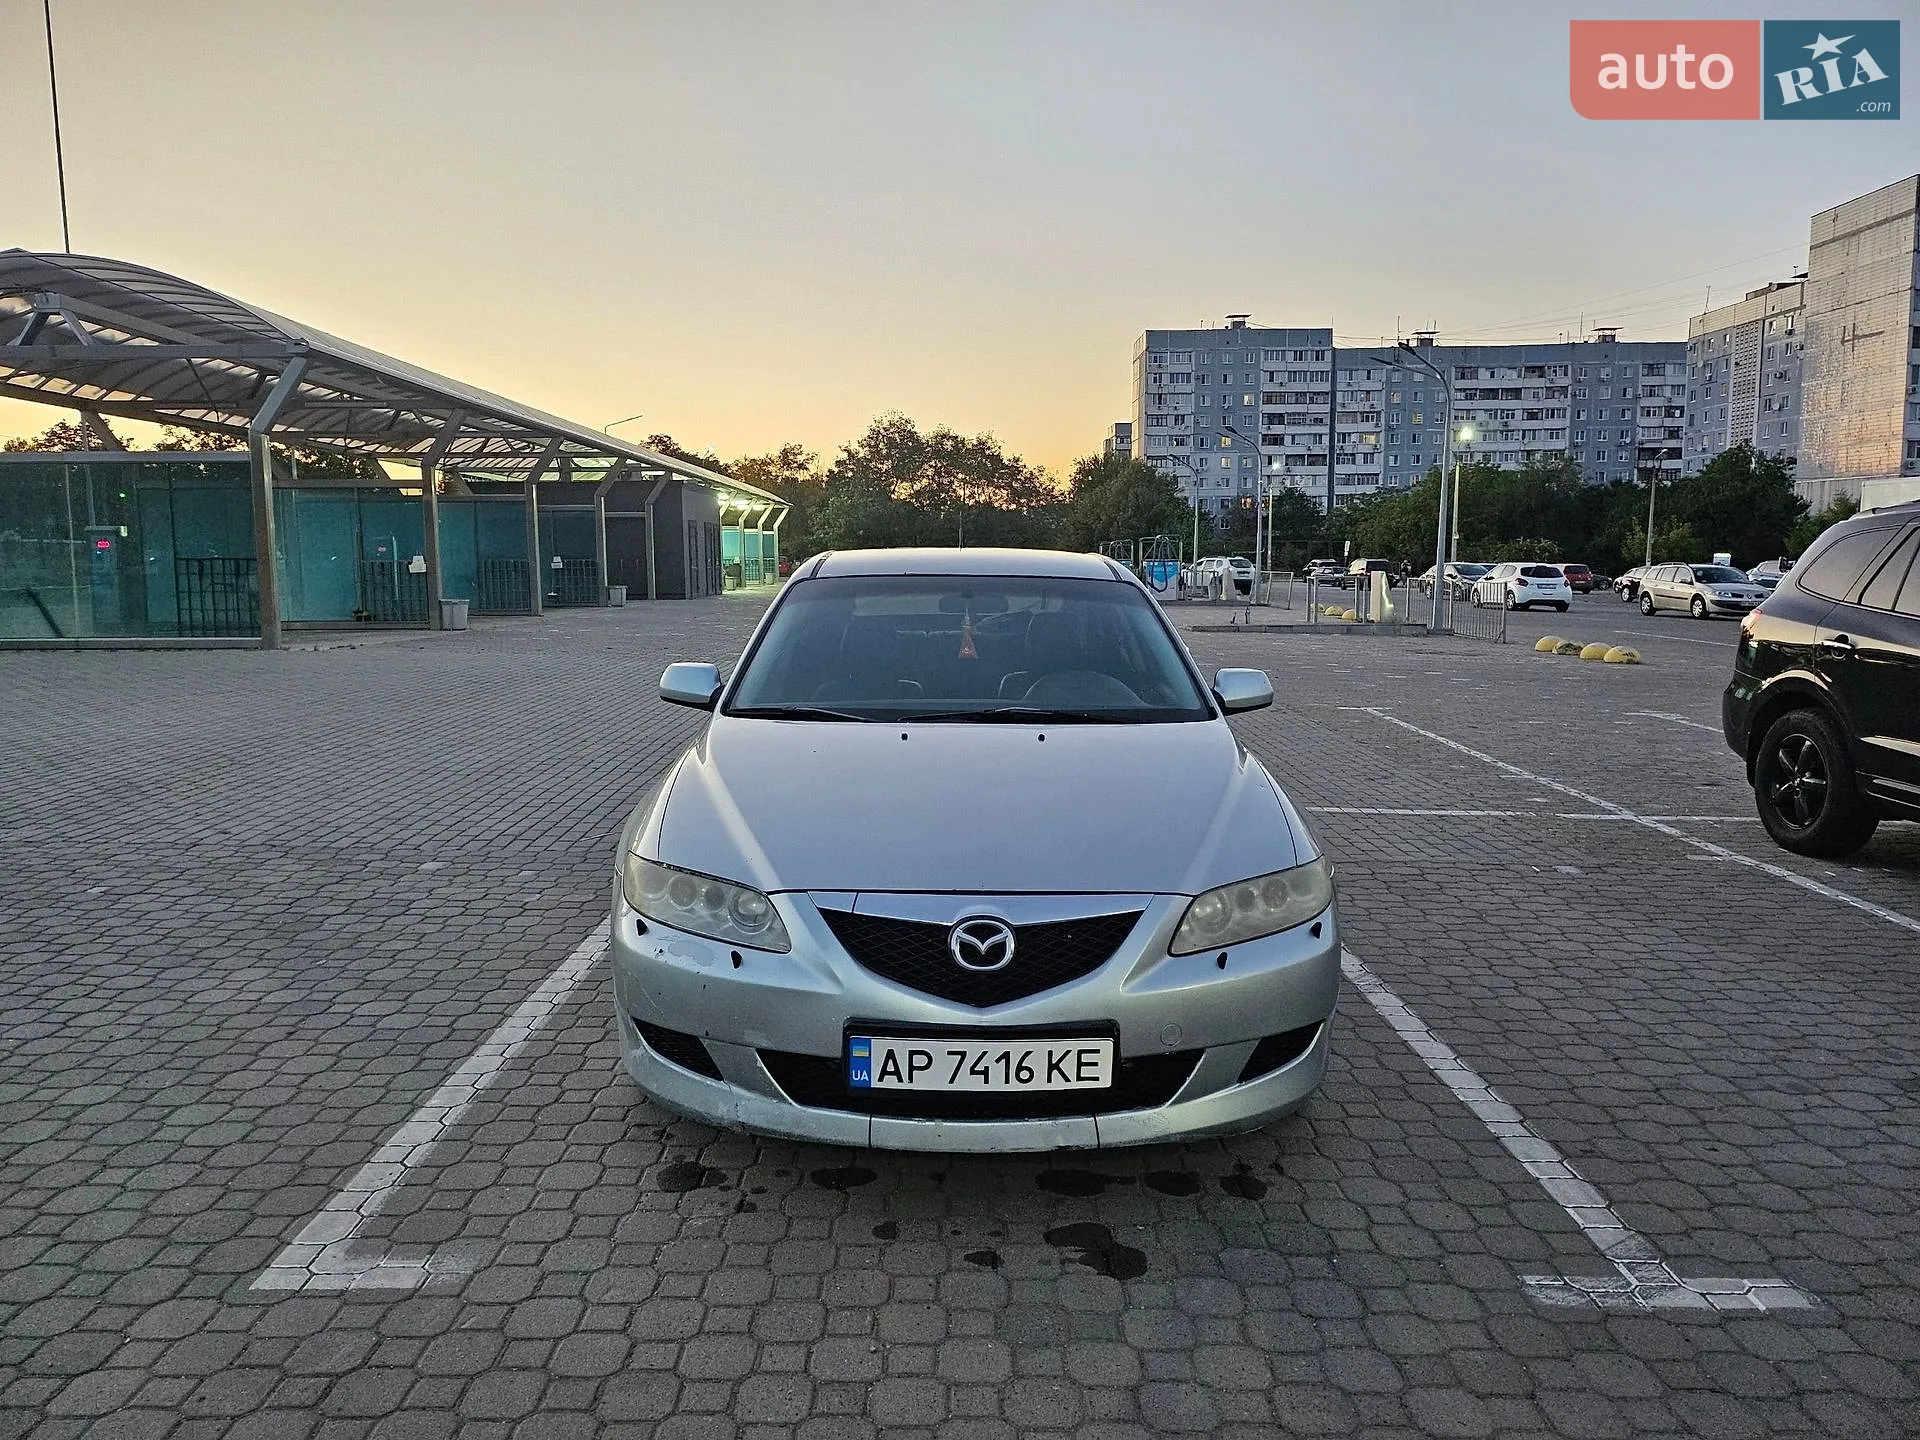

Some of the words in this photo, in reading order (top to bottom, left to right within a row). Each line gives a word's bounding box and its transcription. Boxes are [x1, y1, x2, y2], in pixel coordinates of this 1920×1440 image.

[852, 1069, 869, 1082] UA
[877, 1048, 934, 1084] AP
[946, 1049, 1036, 1085] 7416
[1046, 1048, 1101, 1085] KE
